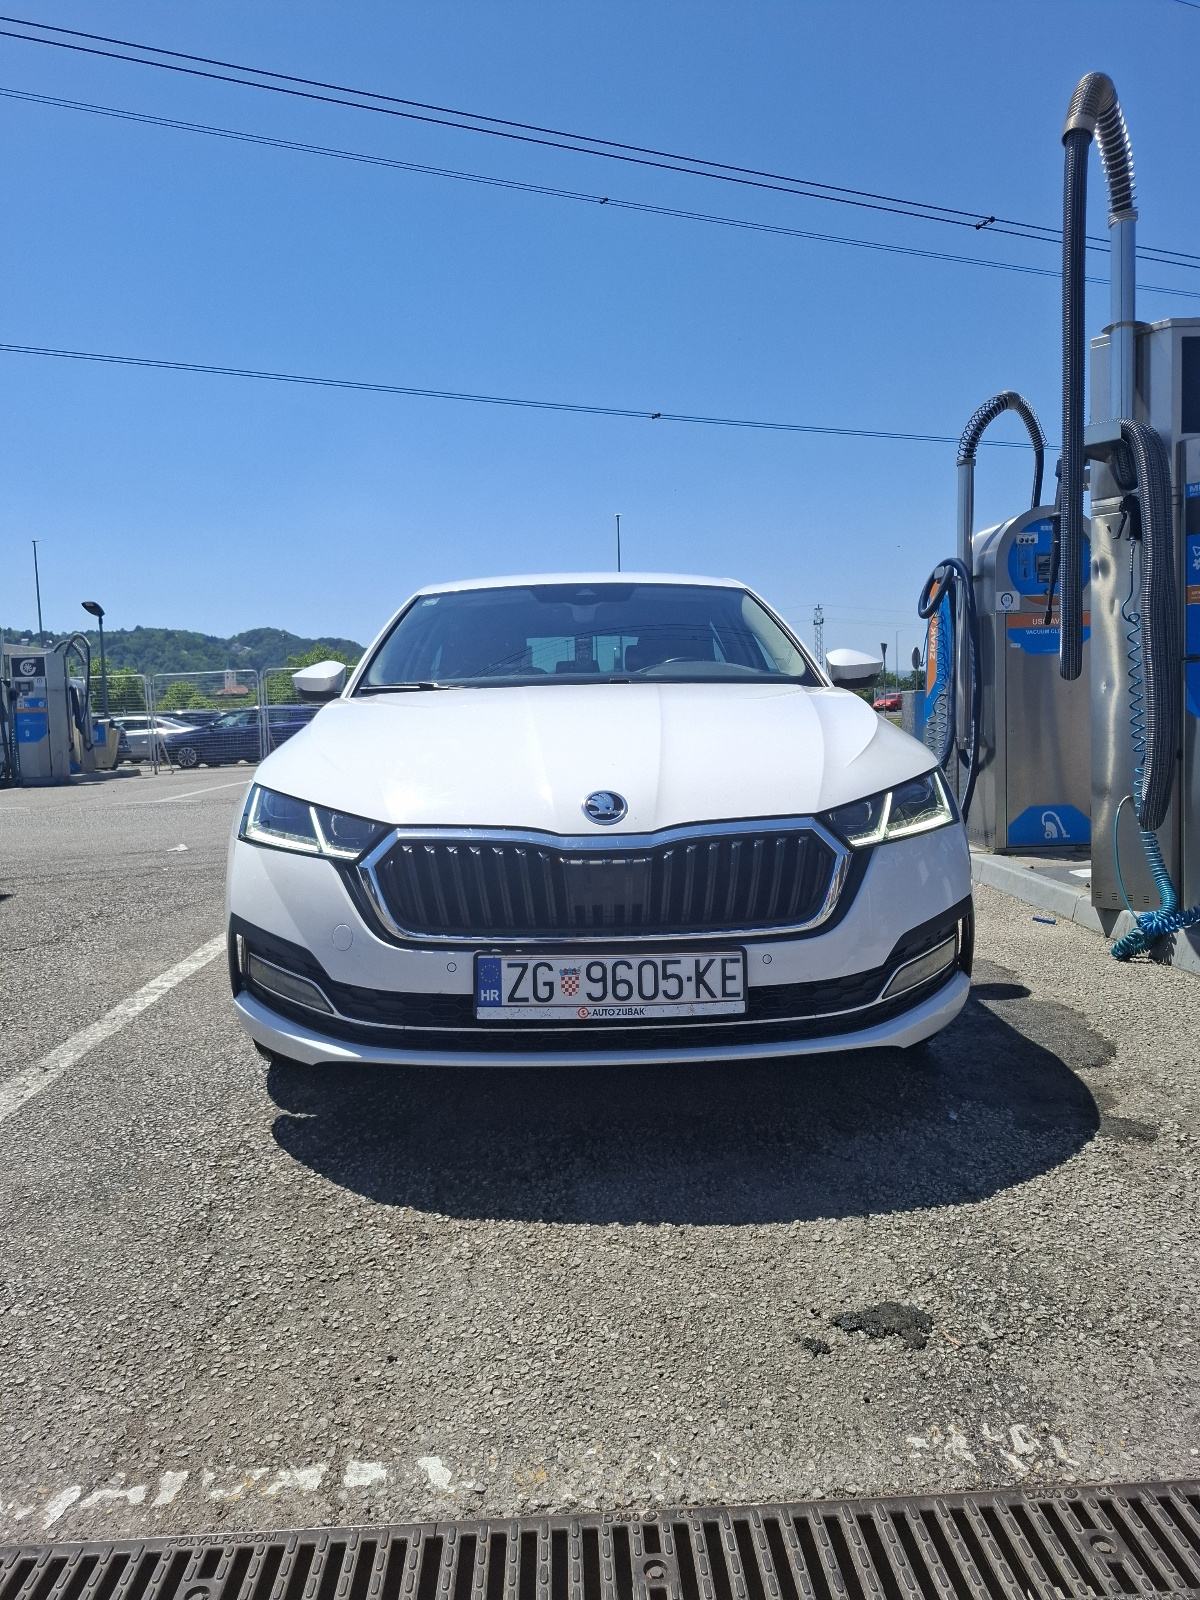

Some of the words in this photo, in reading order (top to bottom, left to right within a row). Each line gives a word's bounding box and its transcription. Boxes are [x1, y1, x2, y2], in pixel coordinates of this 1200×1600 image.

[1025, 628, 1050, 636] VACUUM
[506, 961, 555, 1003] ZG
[480, 989, 499, 1002] HR
[592, 1008, 615, 1017] AUTO
[616, 1007, 646, 1016] ZUBAK
